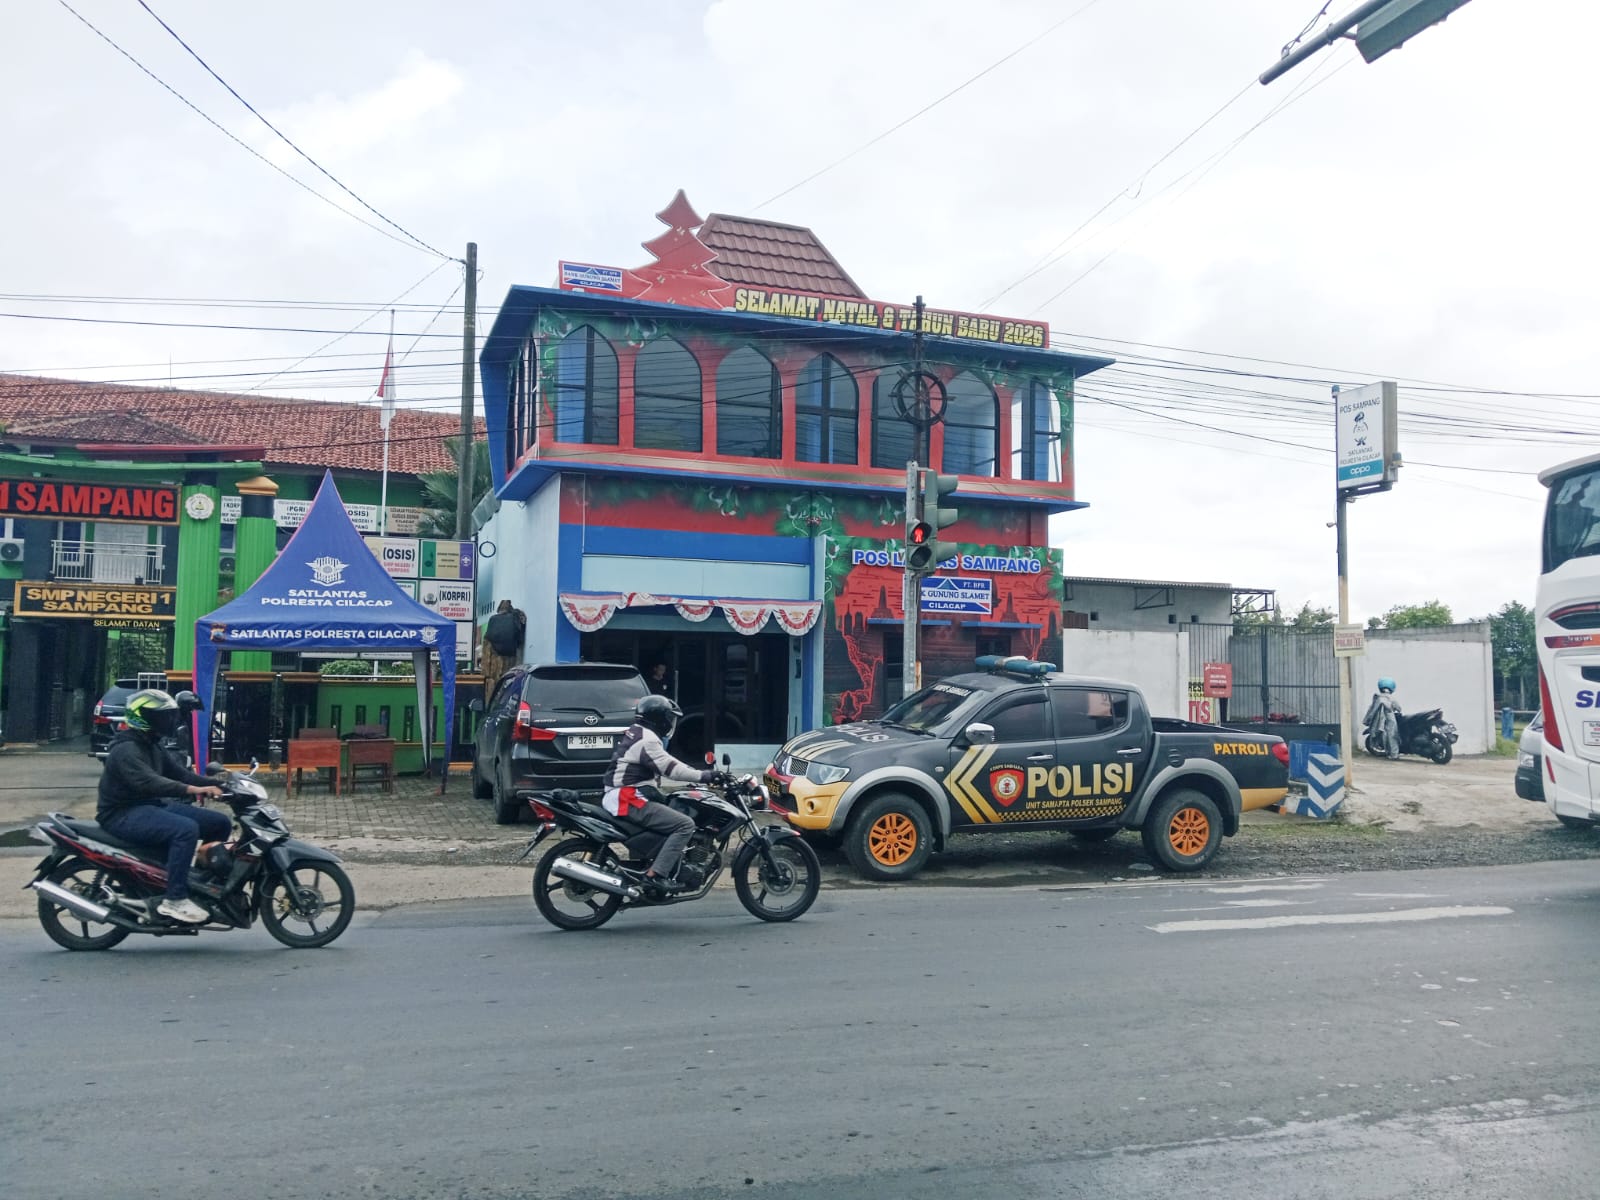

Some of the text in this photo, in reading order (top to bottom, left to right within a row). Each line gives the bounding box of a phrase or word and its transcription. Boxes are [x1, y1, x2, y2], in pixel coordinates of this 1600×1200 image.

[735, 288, 820, 319] SELAMAT
[822, 298, 879, 327] NATAL
[898, 308, 954, 336] TAHUN
[956, 314, 1001, 342] BARU
[1003, 321, 1045, 347] 2026
[1340, 397, 1381, 414] POS SAMPANG
[16, 481, 175, 519] SAMPANG
[383, 546, 415, 562] (OSIS)
[852, 549, 889, 566] POS
[962, 554, 1041, 573] SAMPANG
[27, 588, 170, 605] SMP NEGERI 1
[288, 589, 367, 598] SATLANTAS
[439, 590, 471, 602] (KORPRI)
[927, 591, 959, 599] GUNUNG
[960, 592, 990, 600] SLAMET
[43, 601, 153, 613] SAMPANG
[261, 597, 393, 607] POLRESTA CILACAP
[928, 602, 966, 610] CILACAP
[94, 619, 132, 628] SELAMAT
[230, 629, 417, 639] SATLANTAS POLRESTA CILACAP
[1213, 743, 1269, 756] PATROLI
[1027, 762, 1134, 799] POLISI
[1025, 801, 1041, 809] UNIT
[1041, 800, 1070, 809] SAMAPTA
[1070, 799, 1095, 808] POLSEK
